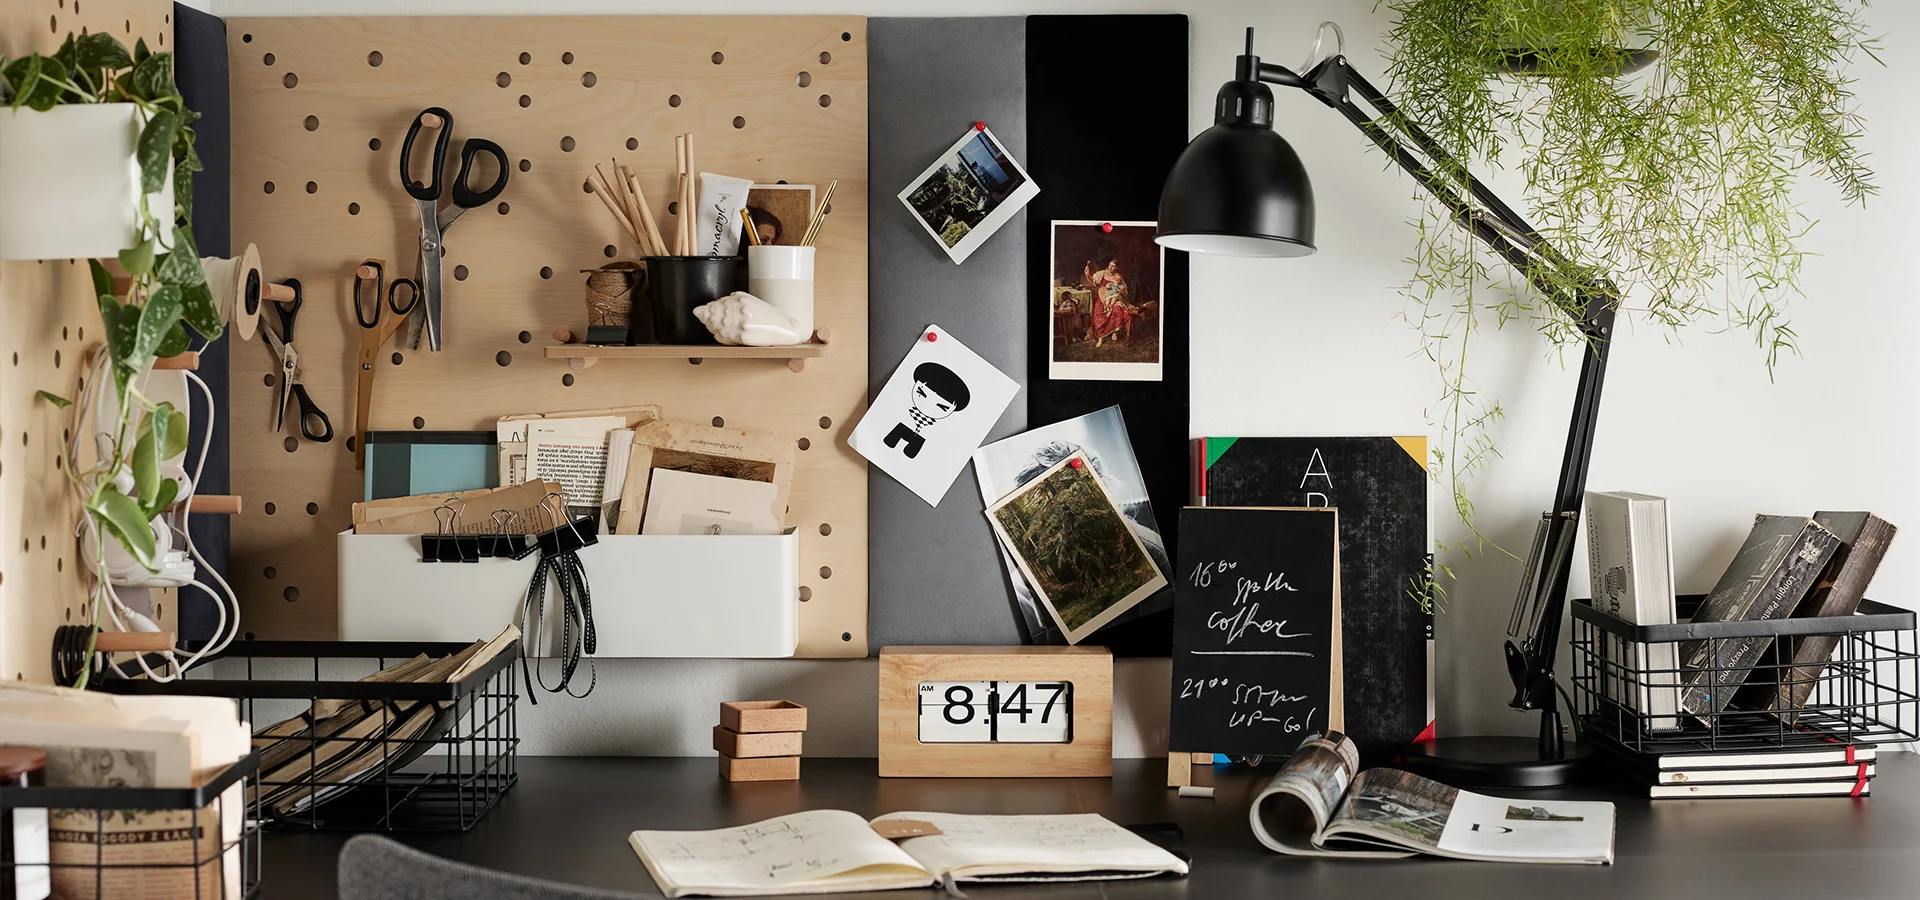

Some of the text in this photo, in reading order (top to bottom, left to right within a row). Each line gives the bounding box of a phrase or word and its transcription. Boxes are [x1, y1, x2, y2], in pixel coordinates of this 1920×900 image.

[711, 203, 728, 257] omacryl
[1760, 600, 1779, 620] Pastu
[163, 828, 194, 841] ŁĄK
